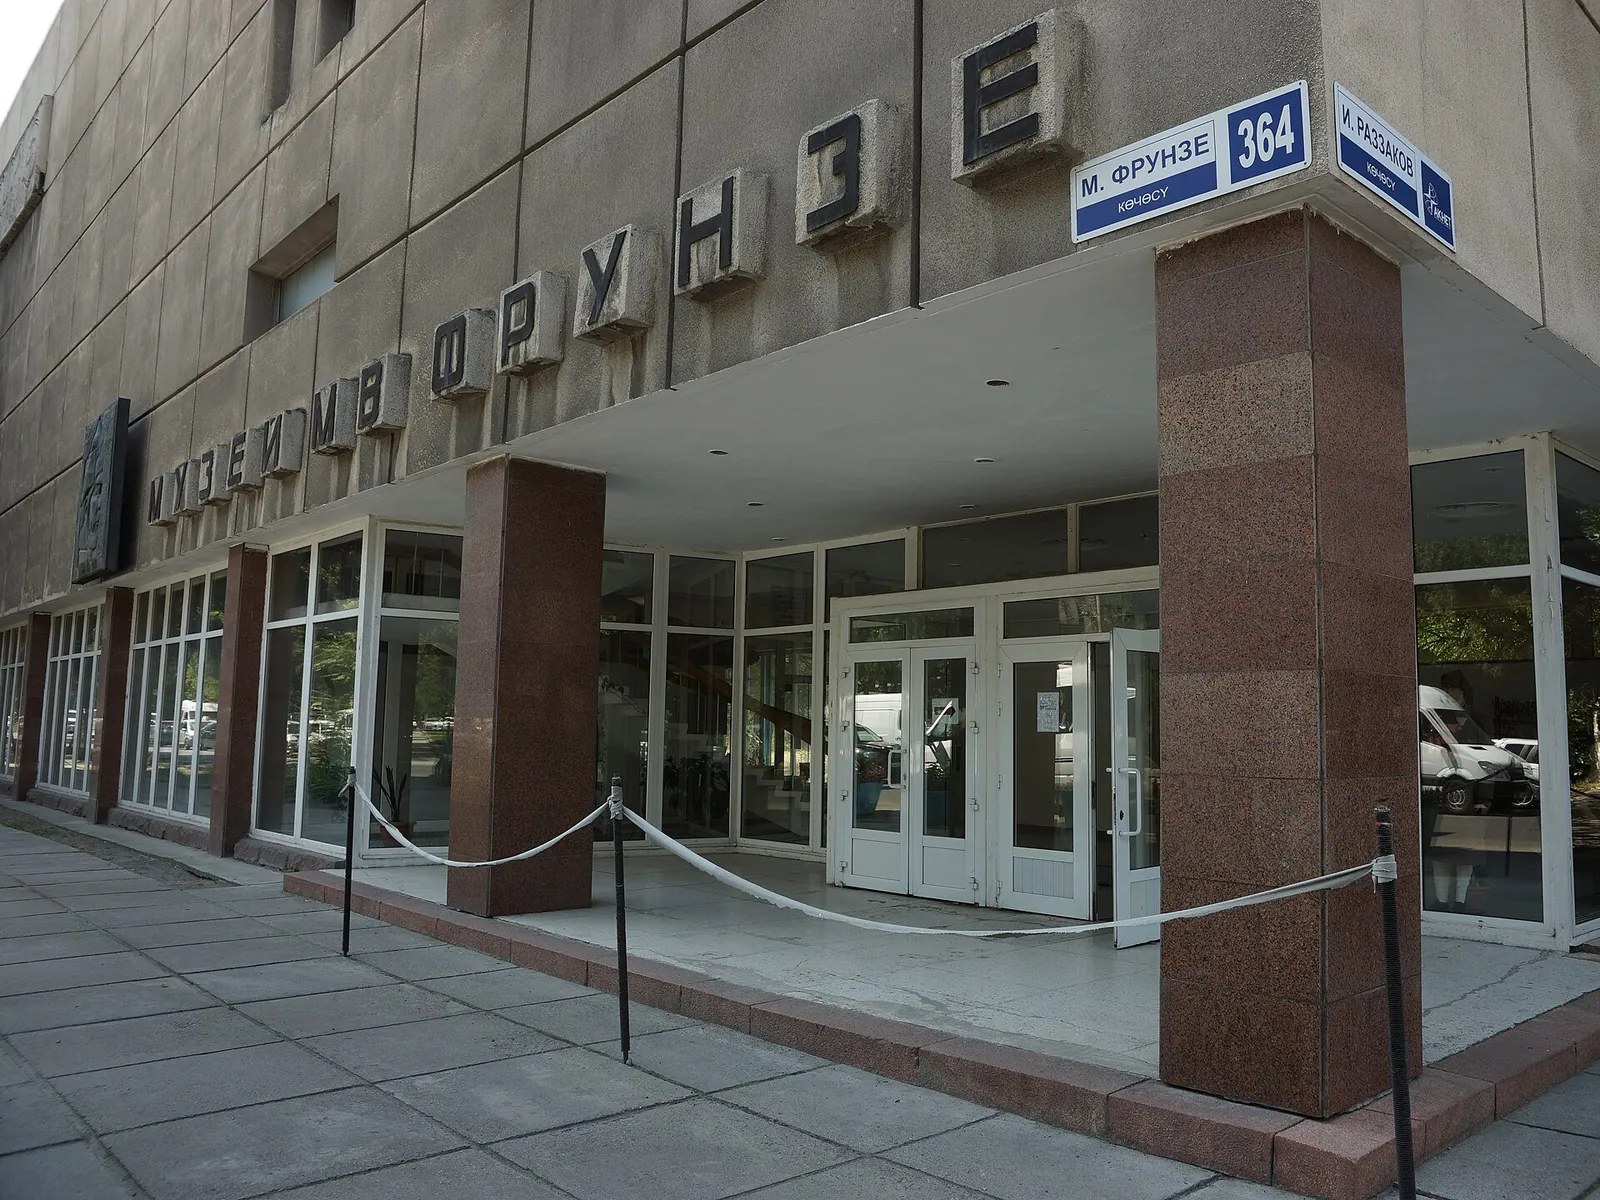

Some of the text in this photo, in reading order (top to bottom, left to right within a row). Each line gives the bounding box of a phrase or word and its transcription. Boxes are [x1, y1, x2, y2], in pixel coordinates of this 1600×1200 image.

[1081, 132, 1210, 197] М. ФРУНЗЕ
[1237, 103, 1295, 170] 364
[1342, 104, 1414, 178] И. РАЗЗАКОВ
[432, 22, 1039, 394] ФРУНЗЕ
